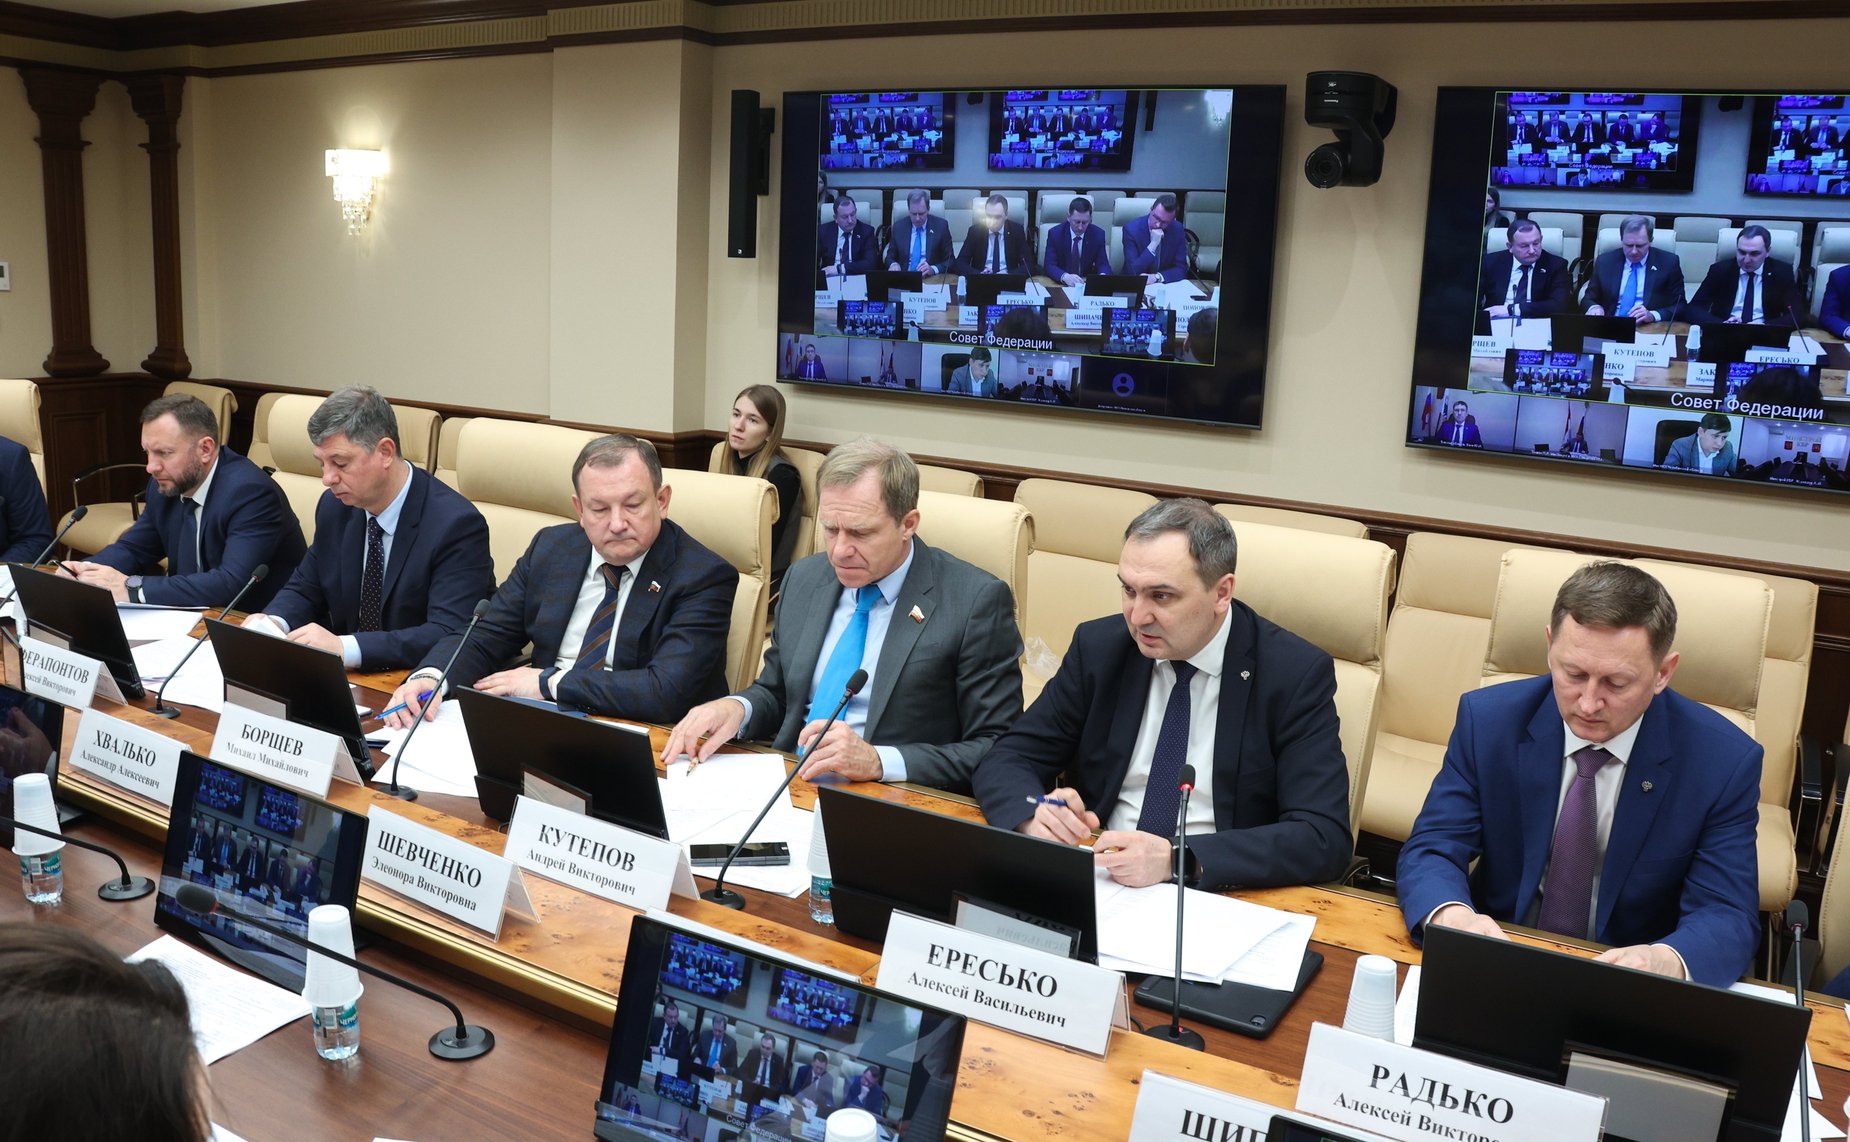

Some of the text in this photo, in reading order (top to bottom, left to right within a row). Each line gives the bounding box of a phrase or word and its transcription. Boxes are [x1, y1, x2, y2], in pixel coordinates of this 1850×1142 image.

[949, 331, 1053, 351] Совет Федерации
[1614, 349, 1655, 357] КУТЕПОВ
[1759, 356, 1800, 364] ЕРЕСЬКО
[1671, 392, 1824, 422] Совет Федерации
[22, 649, 90, 684] ФЕРАПОНТОВ
[24, 672, 76, 696] ексей Викторович
[93, 730, 156, 767] ХВАЛЬКО
[241, 724, 304, 756] БОРЩЕВ
[80, 750, 160, 789] Александр Алексеевич
[226, 742, 309, 777] Михаил Михайлович
[377, 830, 482, 888] ШЕВЧЕНКО
[538, 824, 635, 872] КУТЕПОВ
[371, 856, 477, 911] Элеонора Викторовна
[526, 849, 636, 896] Андрей Викторович
[926, 943, 1058, 998] ЕРЕСЬКО
[907, 972, 1066, 1028] Алексей Васильевич
[1368, 1064, 1514, 1124] РАДЬКО
[726, 1114, 748, 1129] Совет
[1333, 1092, 1500, 1142] Алексей Викто
